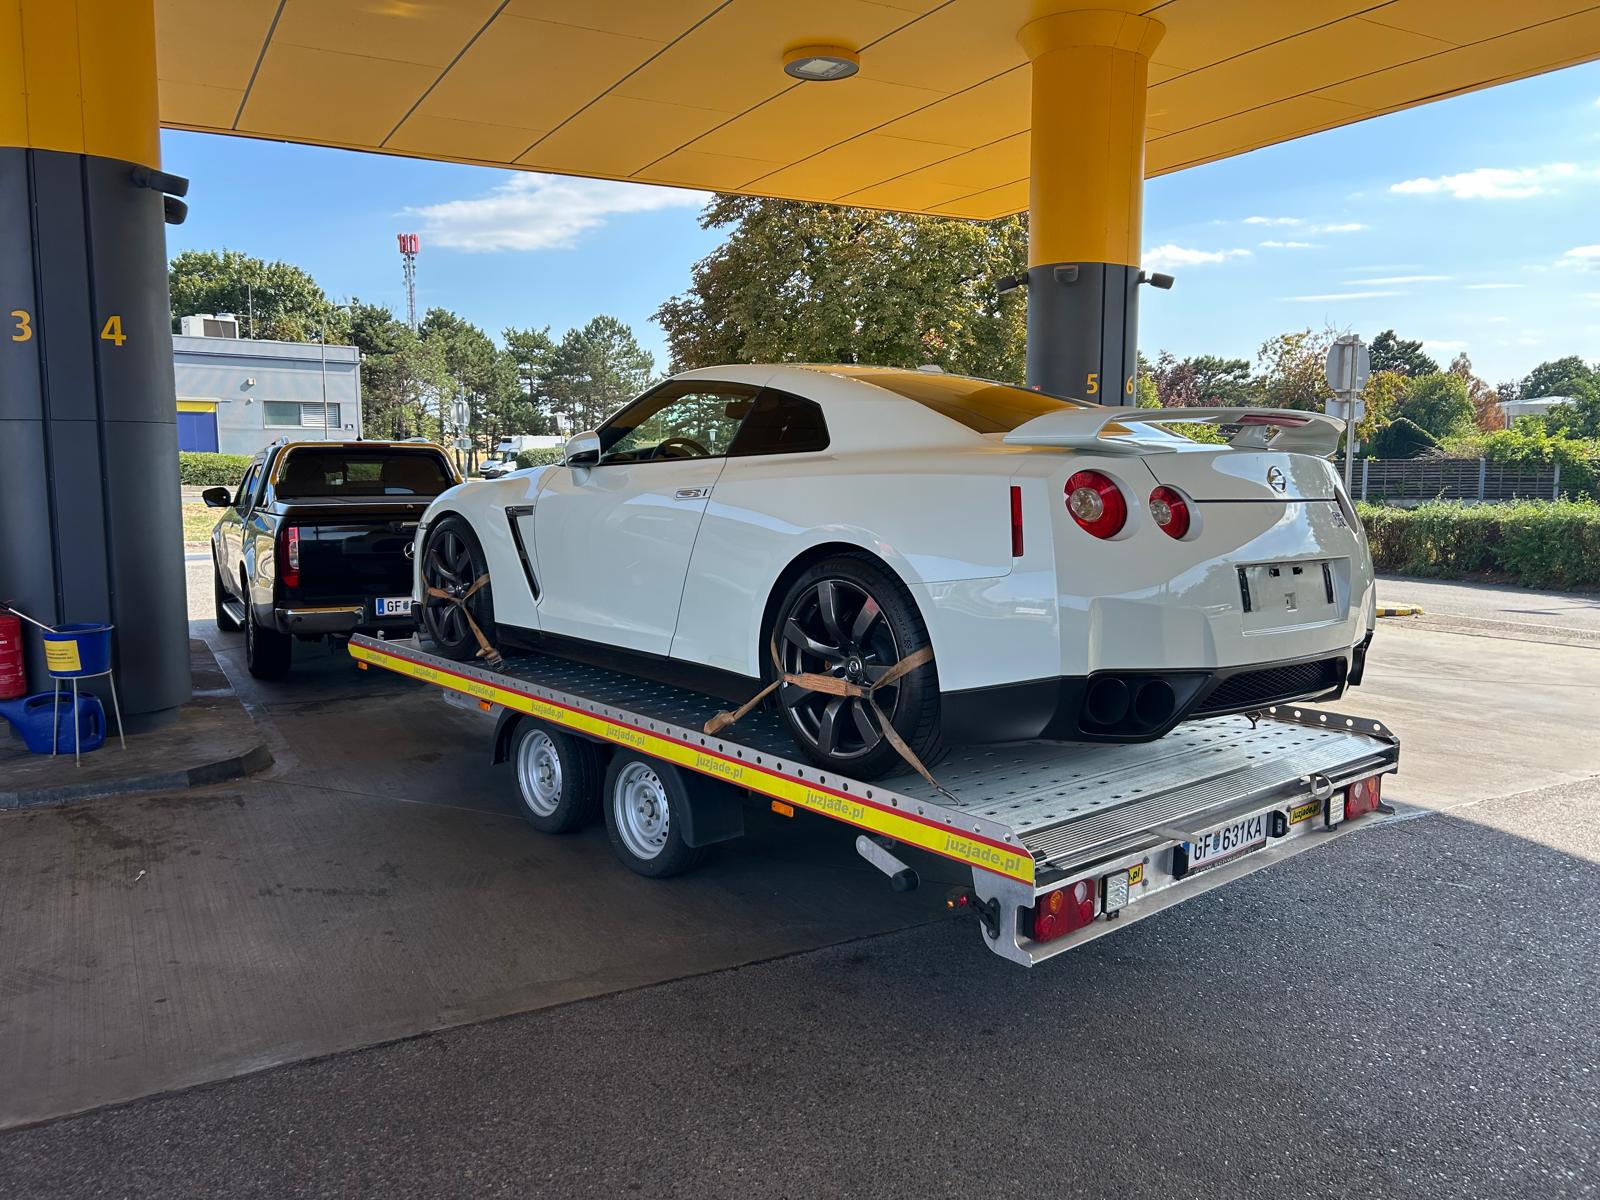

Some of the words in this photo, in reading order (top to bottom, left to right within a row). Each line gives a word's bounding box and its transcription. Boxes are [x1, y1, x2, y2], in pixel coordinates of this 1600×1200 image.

[10, 310, 33, 342] 3
[100, 315, 127, 346] 4
[1086, 373, 1098, 394] 5
[1126, 375, 1134, 395] 6
[387, 600, 402, 612] GF
[467, 682, 496, 698] juzjade.pl
[531, 701, 564, 720] juzjade.pl
[606, 724, 646, 746] juzjade.pl
[696, 754, 744, 779] juzjade.pl
[805, 790, 865, 820] juzjade.pl
[1194, 833, 1213, 860] GF
[1222, 815, 1262, 851] 631KA
[944, 835, 1021, 872] juzjade.pl
